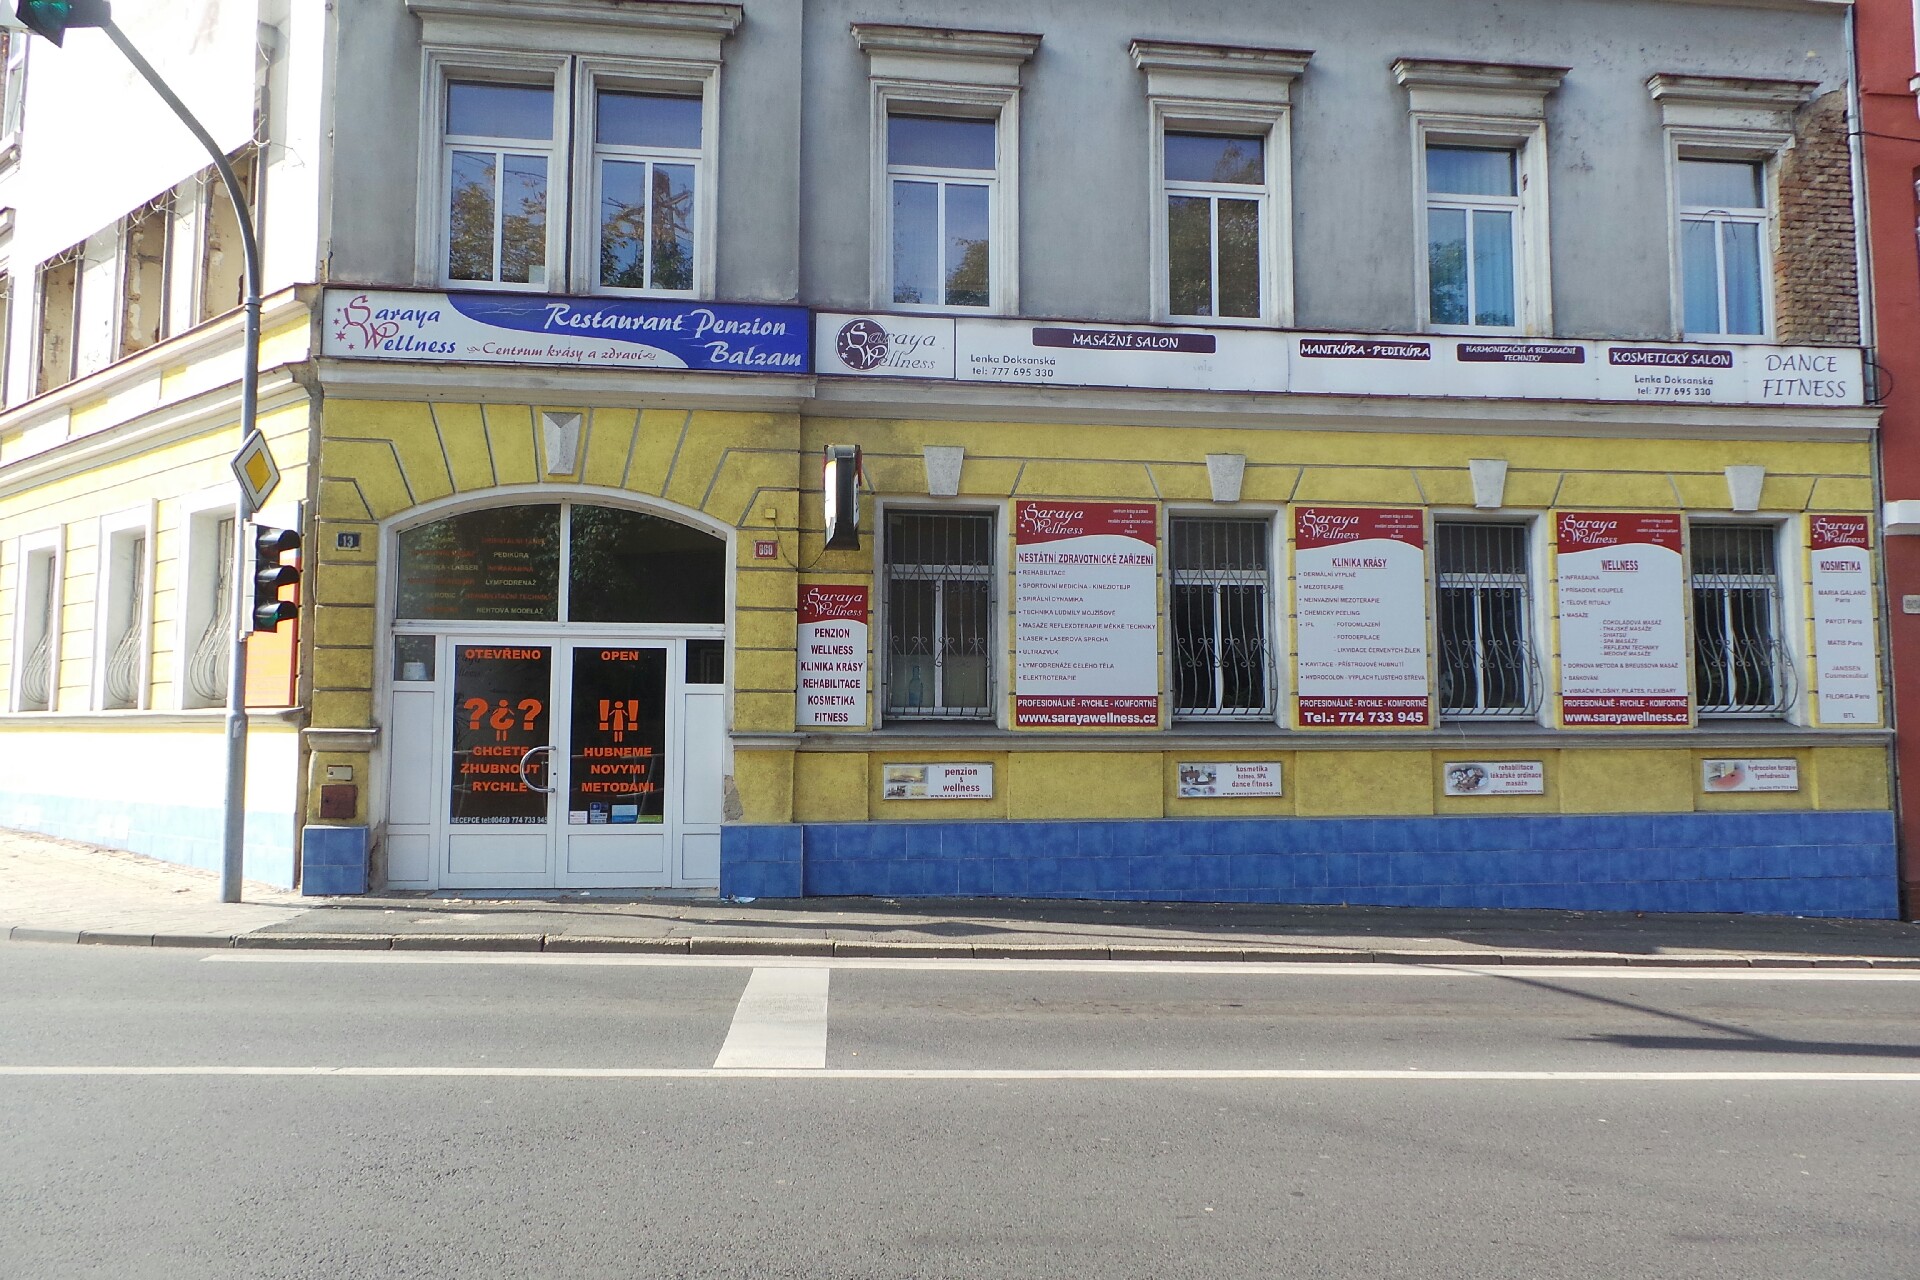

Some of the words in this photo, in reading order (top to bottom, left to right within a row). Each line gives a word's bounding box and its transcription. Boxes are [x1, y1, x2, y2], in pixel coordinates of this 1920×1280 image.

[344, 295, 440, 328] Saraya
[544, 303, 683, 331] Restaurant
[690, 308, 786, 338] Penzion
[343, 321, 456, 354] Wellness
[846, 322, 936, 354] Saraya
[1072, 333, 1133, 347] MASÁŽNÍ
[1135, 336, 1178, 348] SALON
[482, 342, 542, 356] Centrum
[547, 344, 582, 362] krásy
[588, 350, 596, 358] a
[601, 347, 643, 359] zdraví
[704, 340, 801, 366] Balzam
[1301, 342, 1365, 355] MANIKÚRA
[1373, 344, 1430, 357] PEDIKÚRA
[1466, 345, 1527, 354] HARMONIZAČNÍ
[1535, 346, 1576, 354] RELAXAČNÍ
[846, 344, 936, 369] Wellness
[970, 354, 999, 363] Lenka
[1003, 354, 1056, 365] Doksanská
[1613, 352, 1688, 364] KOSMETICKÝ
[1691, 354, 1730, 365] SALON
[1765, 354, 1837, 372] DANCE
[973, 367, 988, 375] tel:
[992, 367, 1009, 376] 777
[1013, 367, 1032, 377] 695
[1035, 368, 1054, 377] 330
[1635, 375, 1661, 383] Lenka
[1664, 375, 1713, 385] Doksanská
[1637, 387, 1651, 395] tel:
[1654, 387, 1670, 395] 777
[1694, 388, 1711, 396] 330
[1763, 379, 1846, 398] FITNESS
[1024, 503, 1083, 524] Saraya
[1303, 509, 1359, 530] Saraya
[1564, 514, 1617, 534] Saraya
[1024, 518, 1083, 535] Wellness
[1303, 523, 1359, 539] Wellness
[1817, 518, 1864, 535] Saraya
[343, 535, 353, 547] 13
[1564, 528, 1617, 544] Wellness
[1820, 530, 1865, 544] Wellness
[1019, 552, 1057, 563] NESTÁTNÍ
[1058, 552, 1117, 564] ZDRAVOTNICKÉ
[1119, 552, 1153, 565] ZAŘÍZENÍ
[1332, 558, 1361, 567] KLINIKA
[1363, 557, 1387, 567] KRÁSY
[1601, 560, 1638, 570] WELLNESS
[1820, 561, 1861, 571] KOSMETIKA
[807, 588, 862, 607] Saraya
[809, 601, 862, 617] Wellness
[814, 628, 850, 638] PENZION
[465, 648, 541, 659] OTEVŘENO
[811, 645, 853, 655] WELLNESS
[601, 651, 639, 661] OPEN
[800, 661, 833, 672] KLINIKA
[836, 660, 863, 672] KRÁSY
[802, 678, 861, 689] REHABILITACE
[807, 695, 855, 706] KOSMETIKA
[1017, 698, 1076, 708] PROFESIONÁLNĚ
[1082, 700, 1109, 708] RYCHLE
[1114, 699, 1157, 708] KOMFORTNĚ
[1300, 698, 1353, 708] PROFESIONÁLNĚ
[1358, 700, 1383, 708] RYCHLE
[1387, 698, 1428, 708] KOMFORTNĚ
[1563, 698, 1615, 707] PROFESIONÁLNĚ
[1649, 698, 1688, 707] KOMFORTNĚ
[814, 712, 849, 723] FITNESS
[1019, 712, 1157, 726] www.sarayawellness.cz
[1304, 712, 1335, 723] Tel.:
[1338, 712, 1365, 723] 774
[1368, 712, 1394, 723] 733
[1397, 712, 1424, 723] 945
[1564, 711, 1688, 724] www.sarayawellness.cz
[472, 746, 529, 756] CHCETE
[584, 747, 652, 757] HUBNEME
[460, 763, 540, 774] ZHUBNOUT
[945, 767, 977, 777] penzion
[472, 781, 528, 792] RYCHLE
[581, 782, 654, 792] METODAMI
[943, 783, 980, 792] wellness
[1231, 780, 1250, 788] dance
[511, 816, 522, 824] 774
[524, 816, 535, 824] 733
